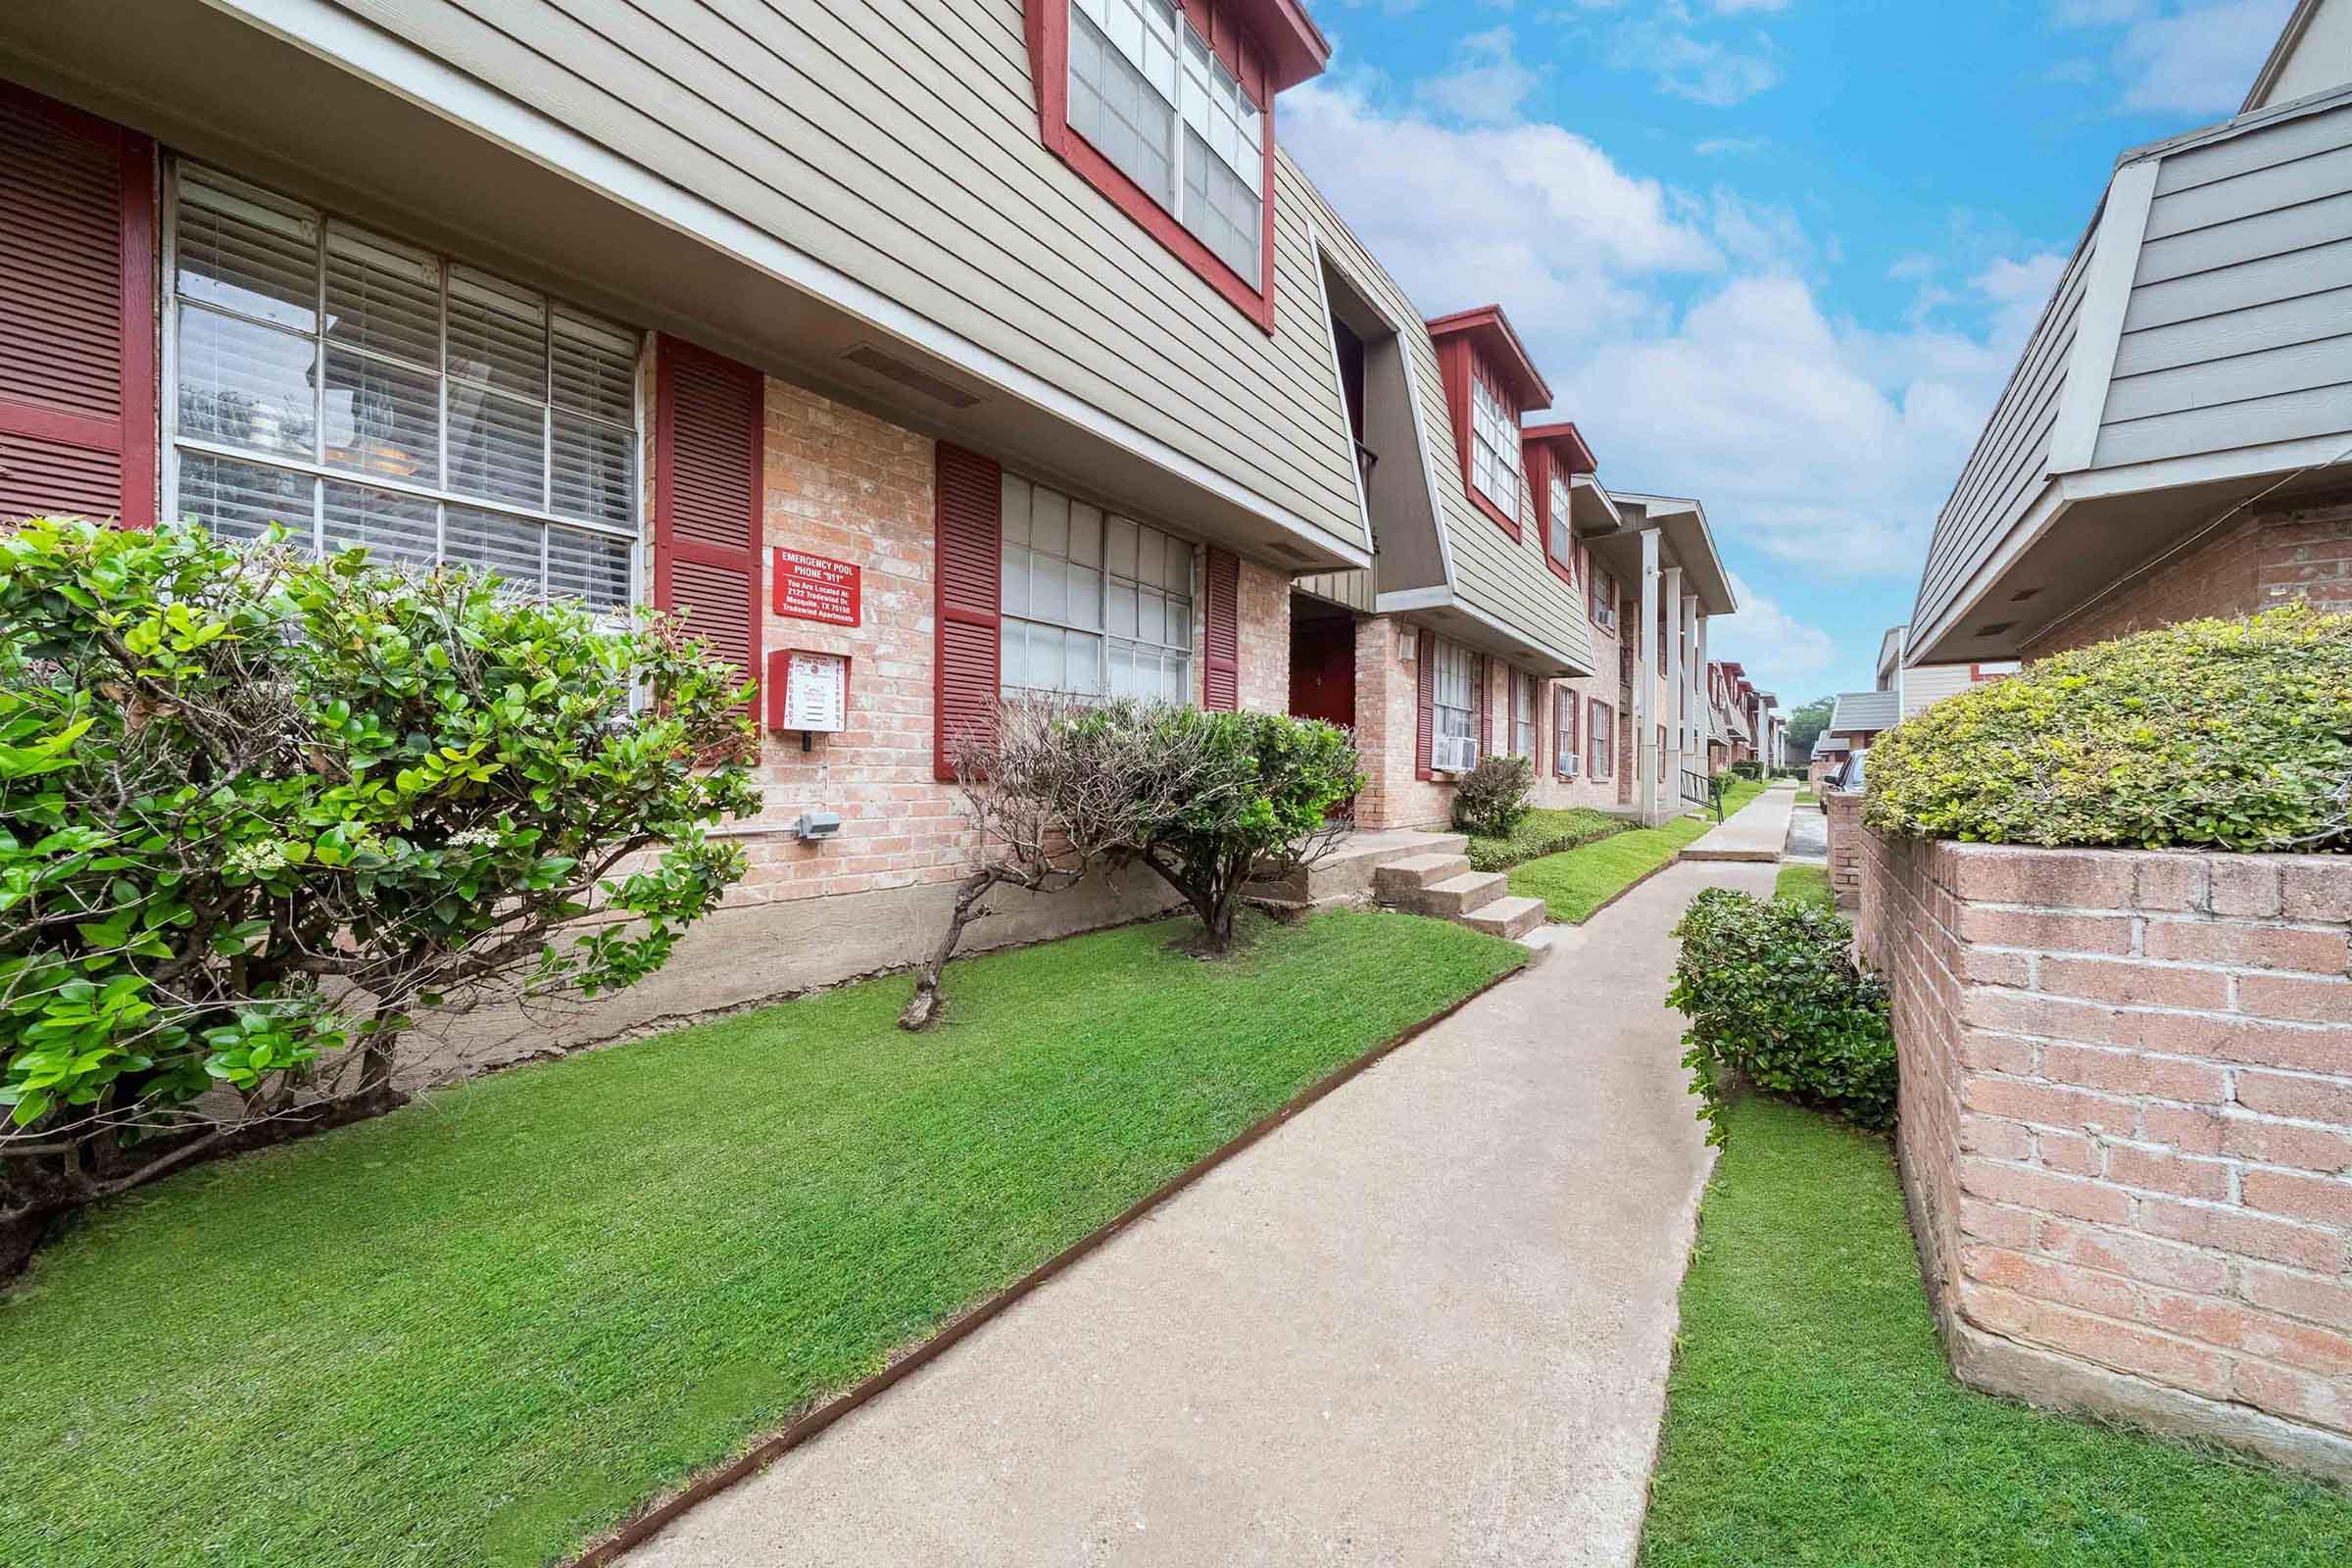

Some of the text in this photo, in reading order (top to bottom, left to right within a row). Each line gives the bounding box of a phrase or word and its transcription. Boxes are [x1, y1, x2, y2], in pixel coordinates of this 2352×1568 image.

[782, 552, 854, 575] EMERGENCY POOL
[794, 565, 822, 578] PHONE
[787, 579, 800, 588] You
[802, 581, 813, 590] Are
[814, 584, 840, 596] Located
[806, 590, 839, 603] Tradewind
[782, 603, 854, 622] Tradewind Apartments
